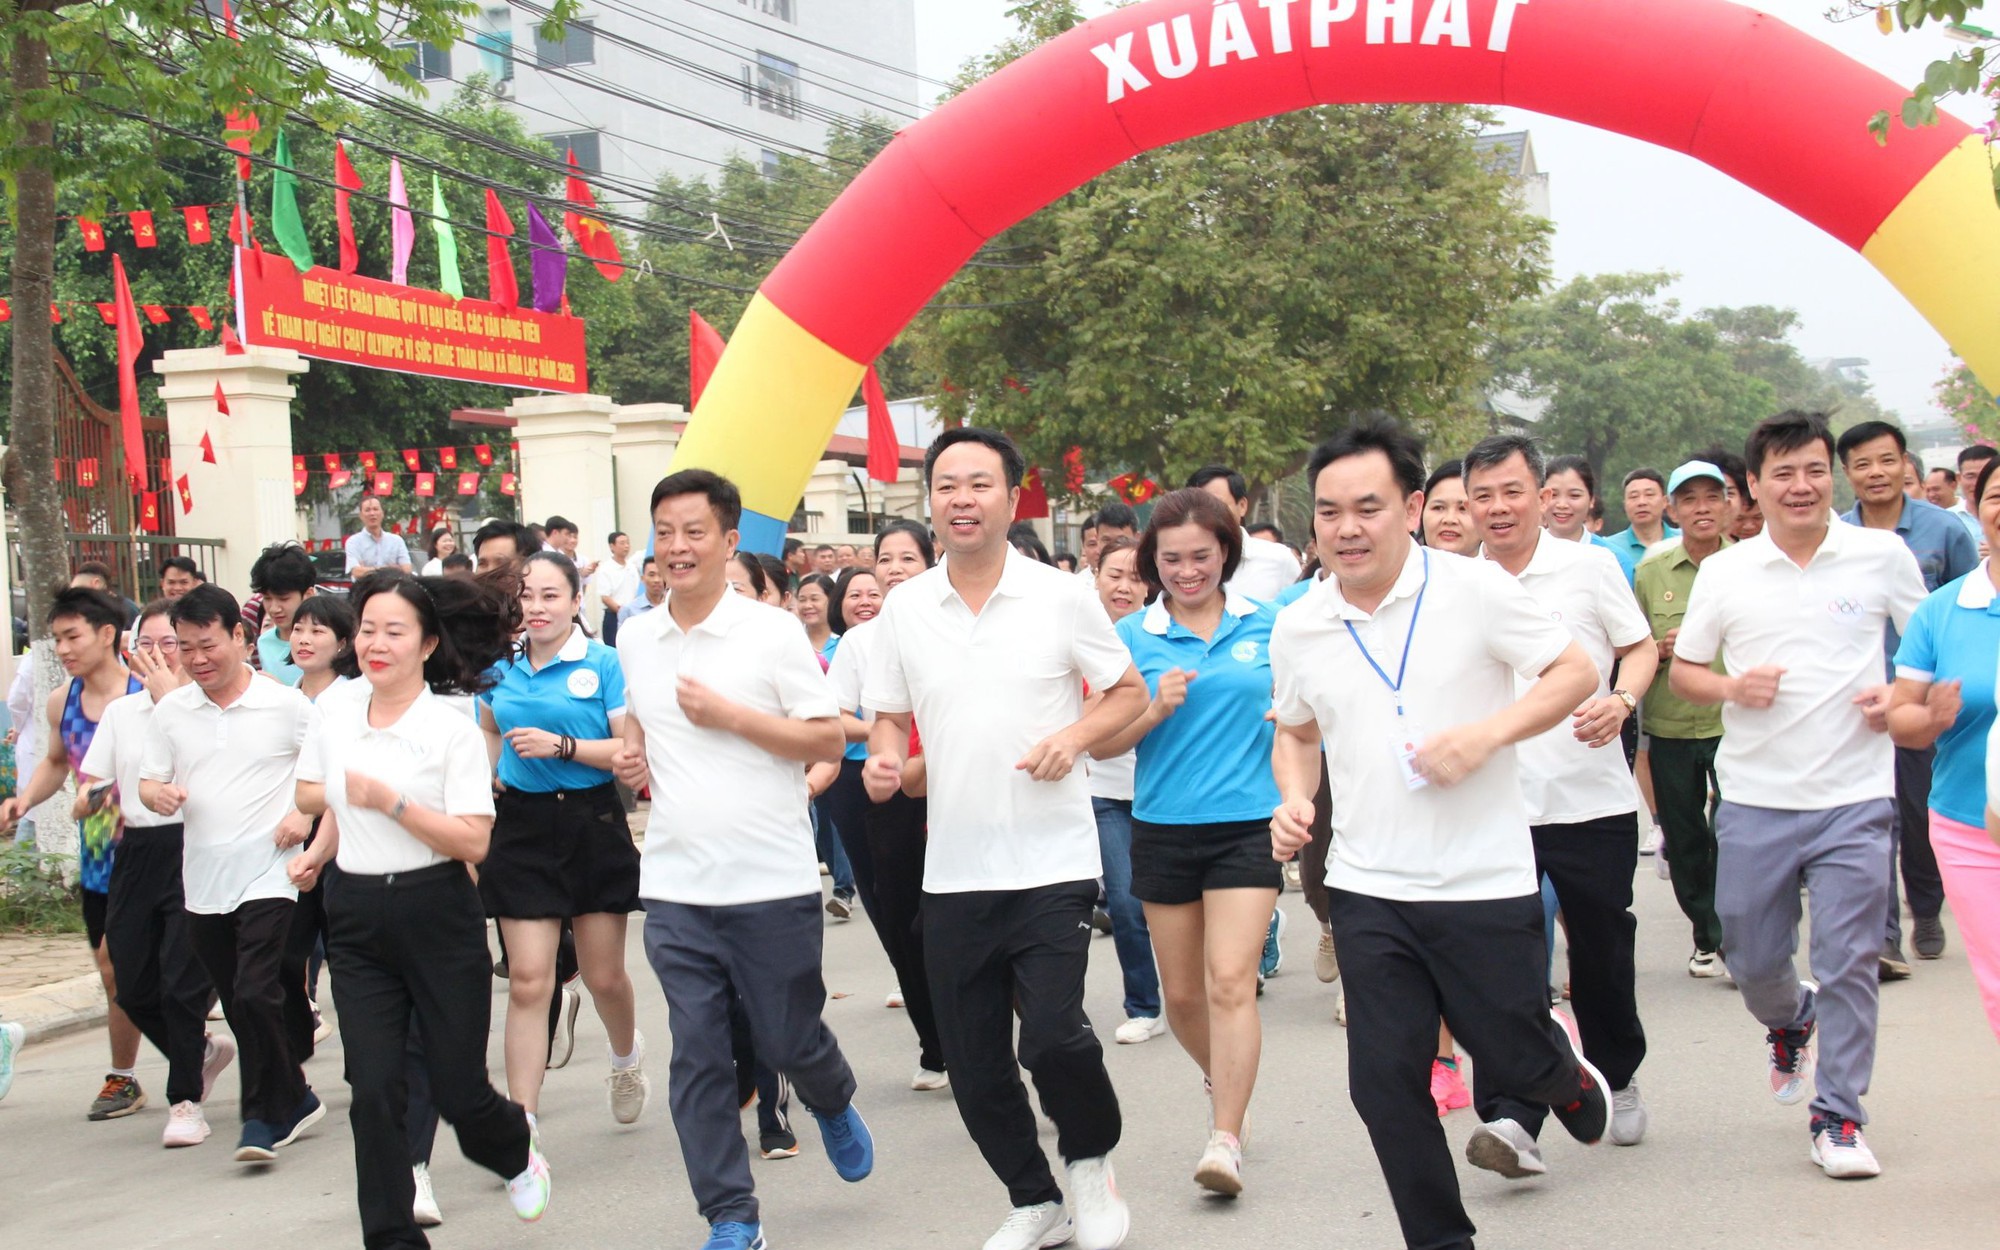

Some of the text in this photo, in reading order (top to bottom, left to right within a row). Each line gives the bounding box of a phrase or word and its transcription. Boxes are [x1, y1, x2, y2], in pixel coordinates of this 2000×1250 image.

[303, 277, 329, 311] NHIỆT
[330, 281, 348, 314] LIỆT
[350, 286, 374, 316] CHÀO
[374, 291, 401, 321] MỪNG
[401, 298, 418, 324] QUÝ
[418, 303, 429, 331] VỊ
[428, 305, 444, 333] ĐẠI
[467, 309, 484, 335] CÁC
[484, 312, 501, 341] VẬN
[522, 319, 541, 344] VIÊN
[276, 313, 303, 341] THAM
[303, 318, 318, 349] DỰ
[318, 320, 342, 349] NGÀY
[367, 332, 404, 359] OLYMPIC
[404, 334, 414, 361] VÌ
[415, 336, 432, 363] SỨC
[456, 343, 477, 370] TOÀN
[477, 347, 495, 373] DÂN
[524, 356, 539, 381] LẠC
[539, 355, 557, 380] NĂM
